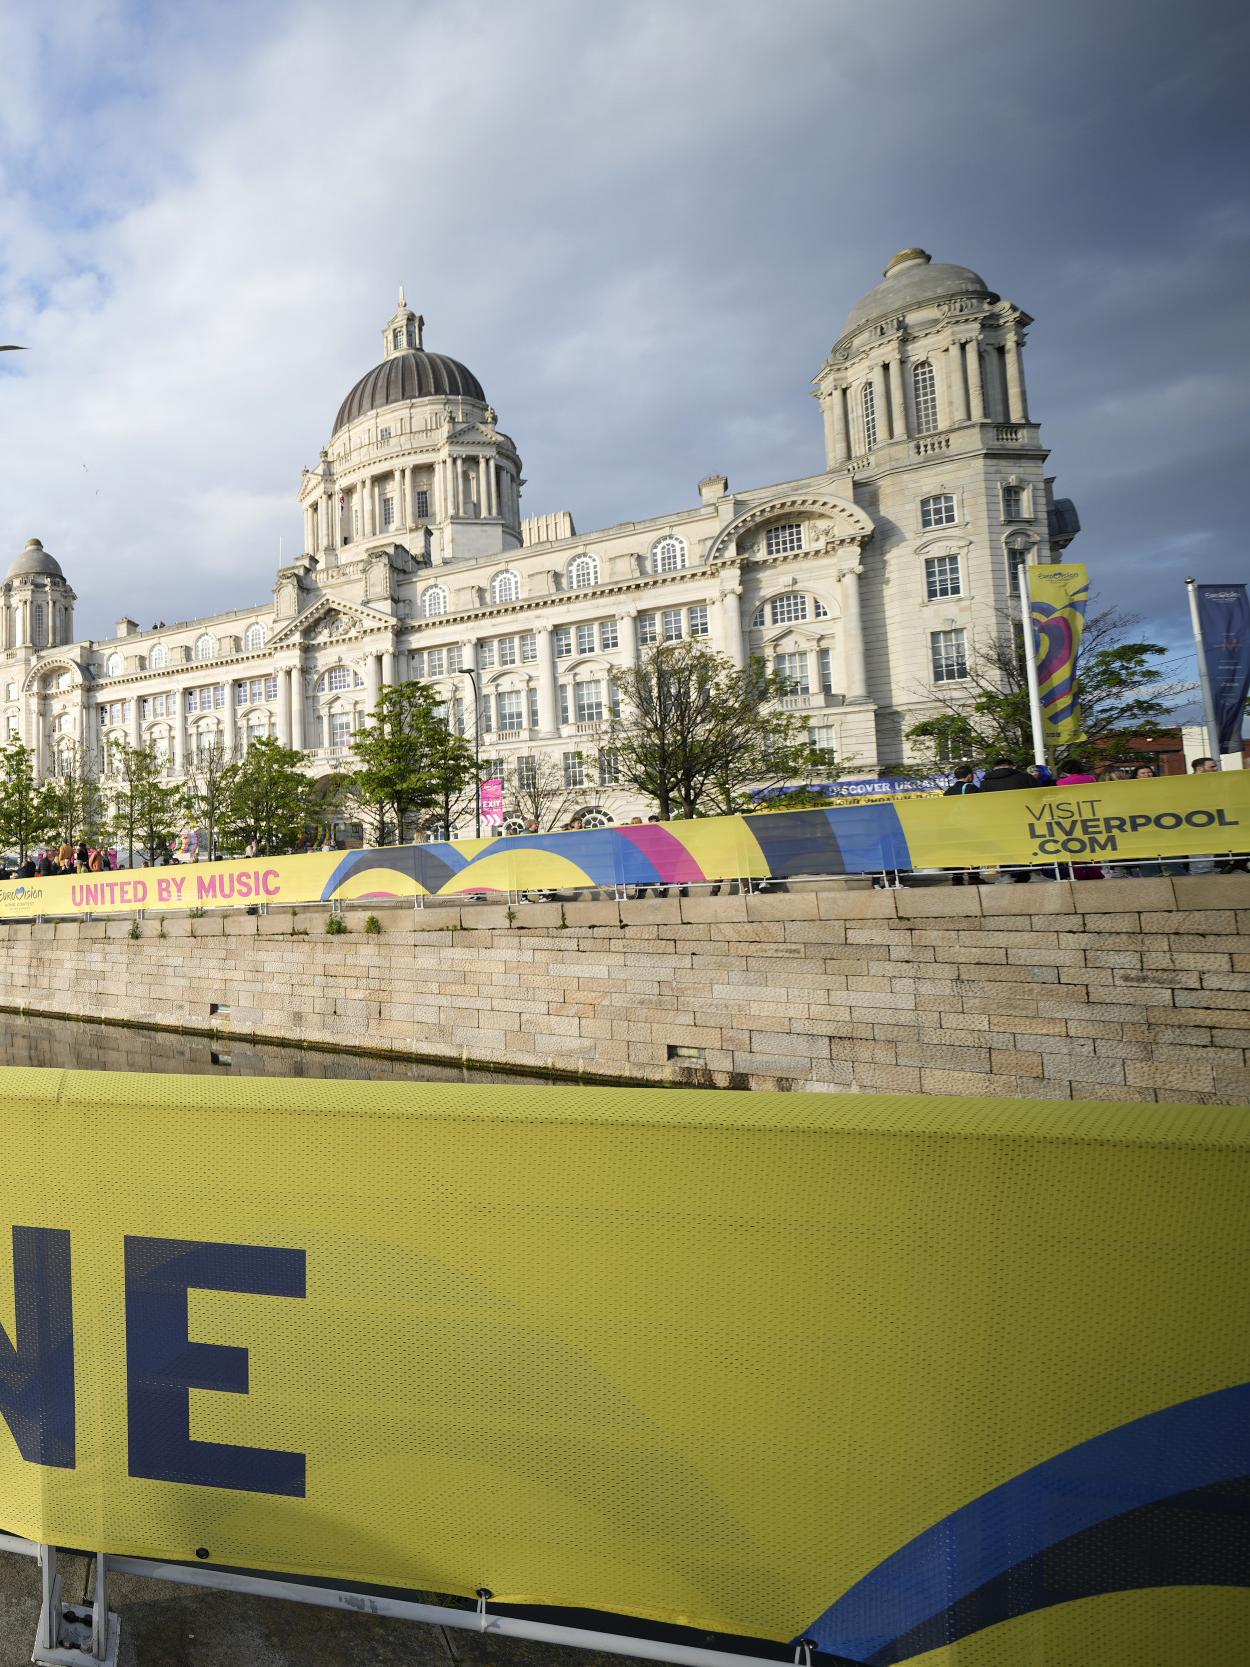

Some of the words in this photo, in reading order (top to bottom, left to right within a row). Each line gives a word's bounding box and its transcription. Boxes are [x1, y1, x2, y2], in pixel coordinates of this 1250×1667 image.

[483, 800, 500, 808] EXIT
[1025, 799, 1102, 821] VISIT
[1028, 809, 1240, 839] LIVERPOOL
[1032, 834, 1118, 856] .COM
[71, 880, 148, 907] UNITED
[157, 877, 186, 902] BY
[196, 869, 281, 900] MUSIC
